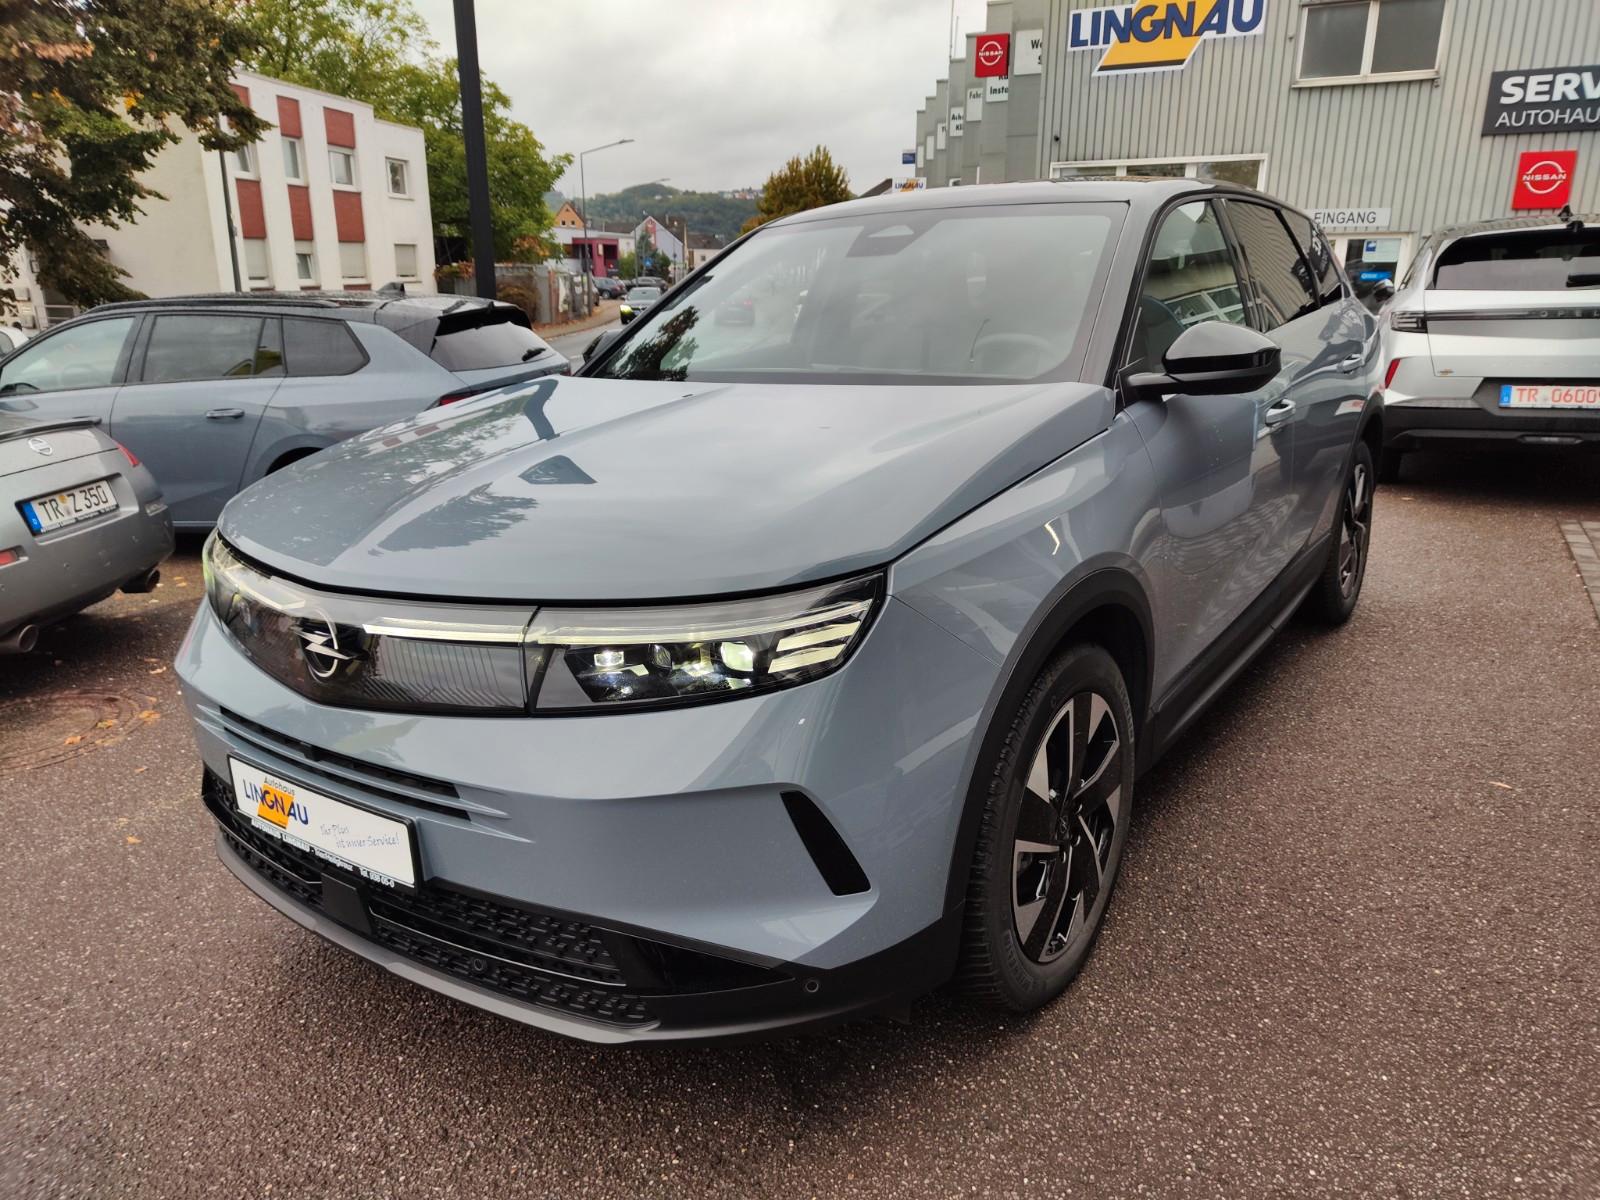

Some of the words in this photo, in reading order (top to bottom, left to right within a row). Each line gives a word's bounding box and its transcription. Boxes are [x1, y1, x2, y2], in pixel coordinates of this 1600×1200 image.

[1070, 0, 1264, 48] LINGNAU
[1500, 72, 1600, 105] SERV
[1495, 107, 1600, 127] AUTOHAU
[1522, 173, 1567, 181] NISSAN
[1314, 211, 1377, 224] EINGANG
[1516, 388, 1538, 402] TR
[1551, 388, 1600, 403] 0600
[38, 498, 64, 522] TR
[67, 492, 83, 513] Z
[79, 485, 109, 509] 350
[264, 777, 296, 796] Autohaus
[243, 778, 308, 825] LINGNAU
